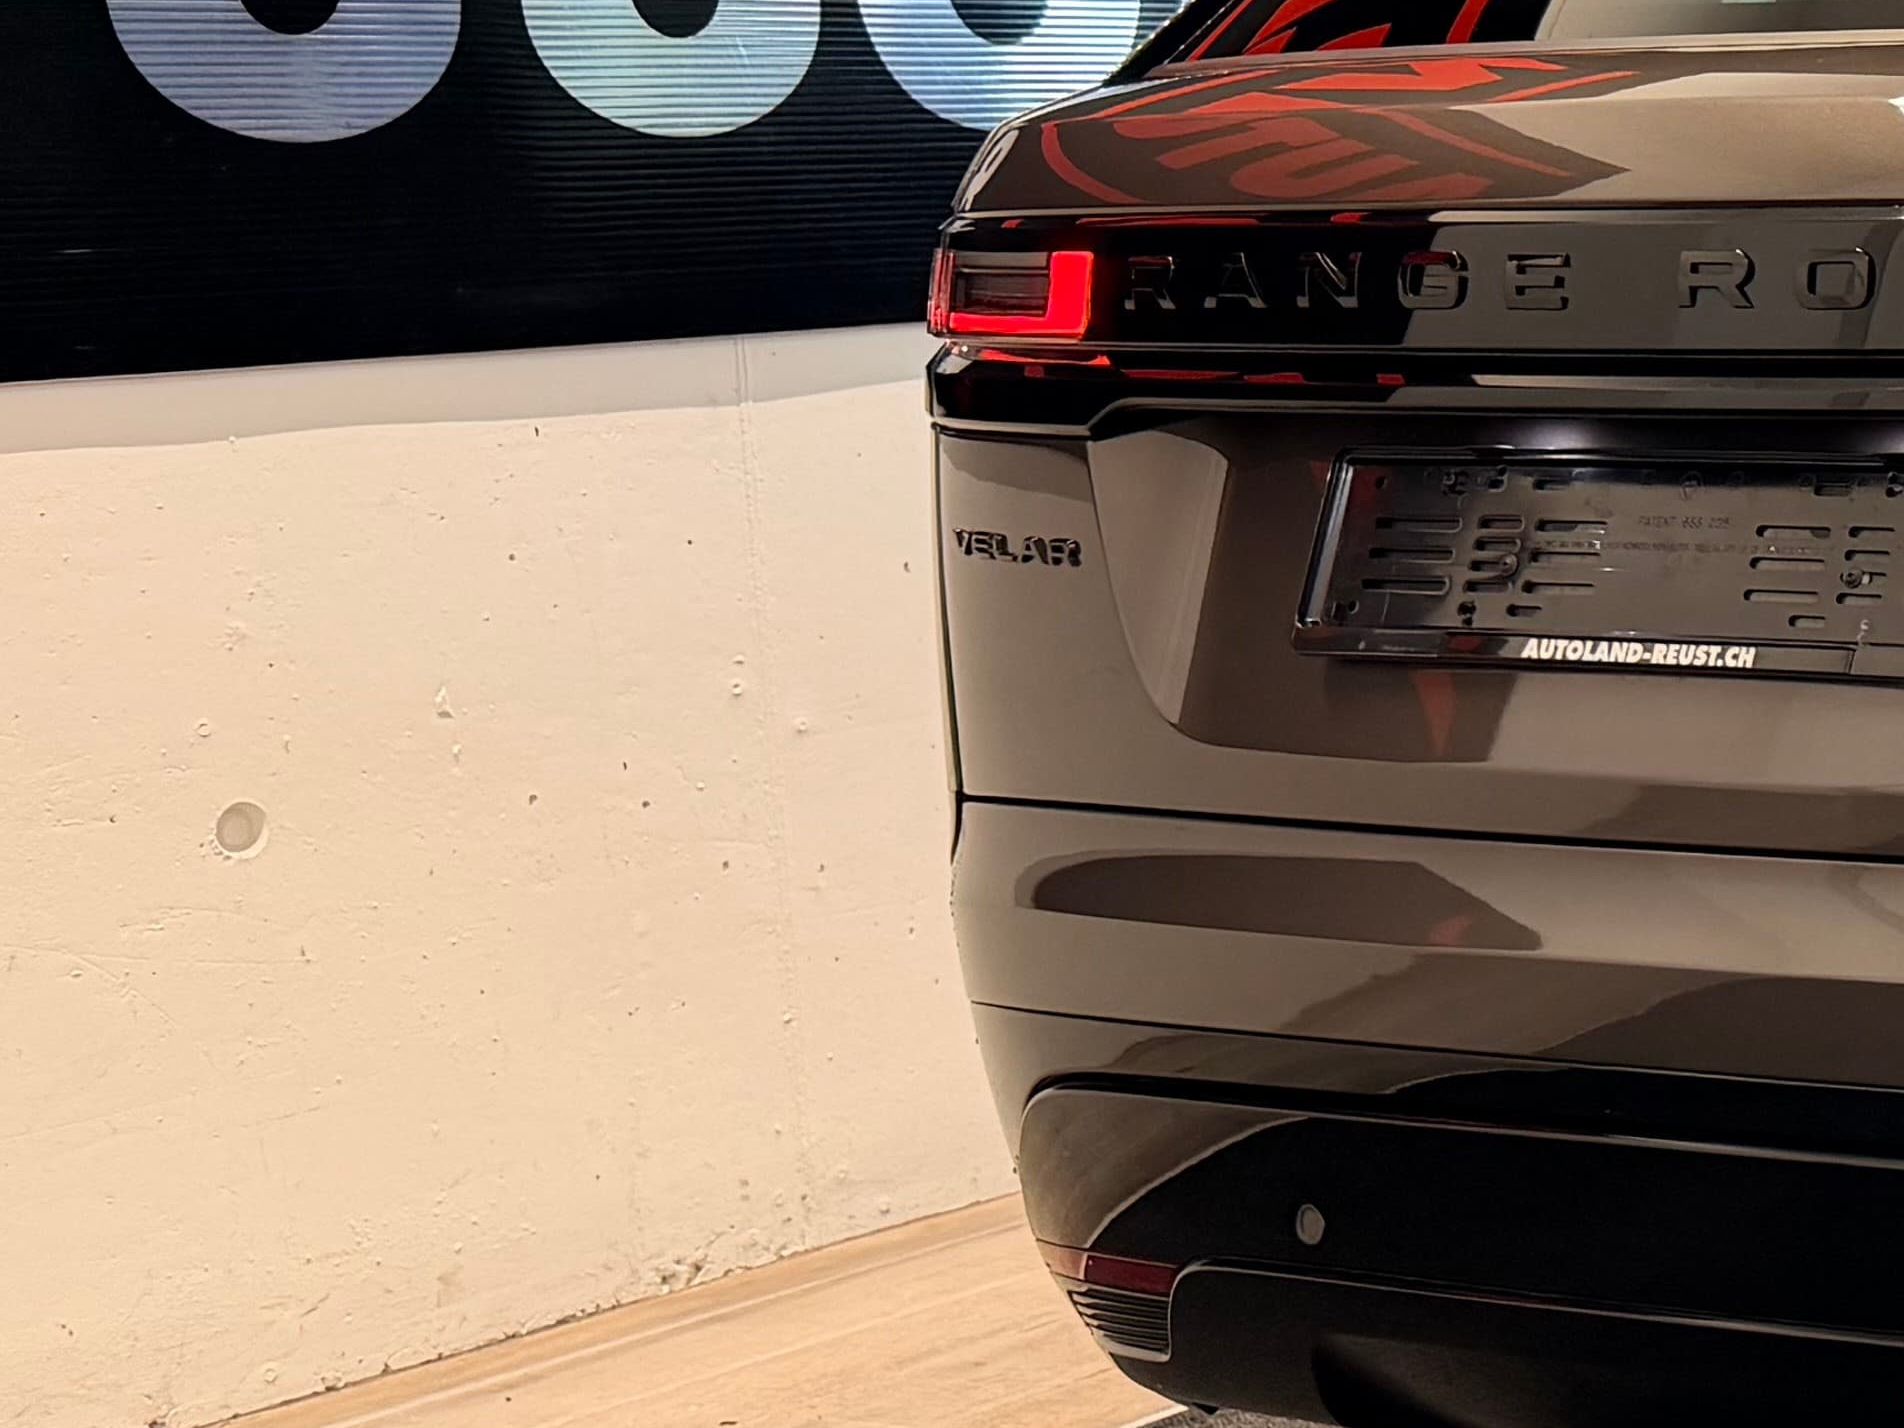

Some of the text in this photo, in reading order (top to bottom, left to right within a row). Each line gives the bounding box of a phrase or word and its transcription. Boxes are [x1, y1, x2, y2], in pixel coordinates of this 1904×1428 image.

[1123, 249, 1573, 311] RANGE
[952, 527, 1083, 567] VELAR
[1520, 638, 1757, 668] AUTOLAND-REUST.CH
